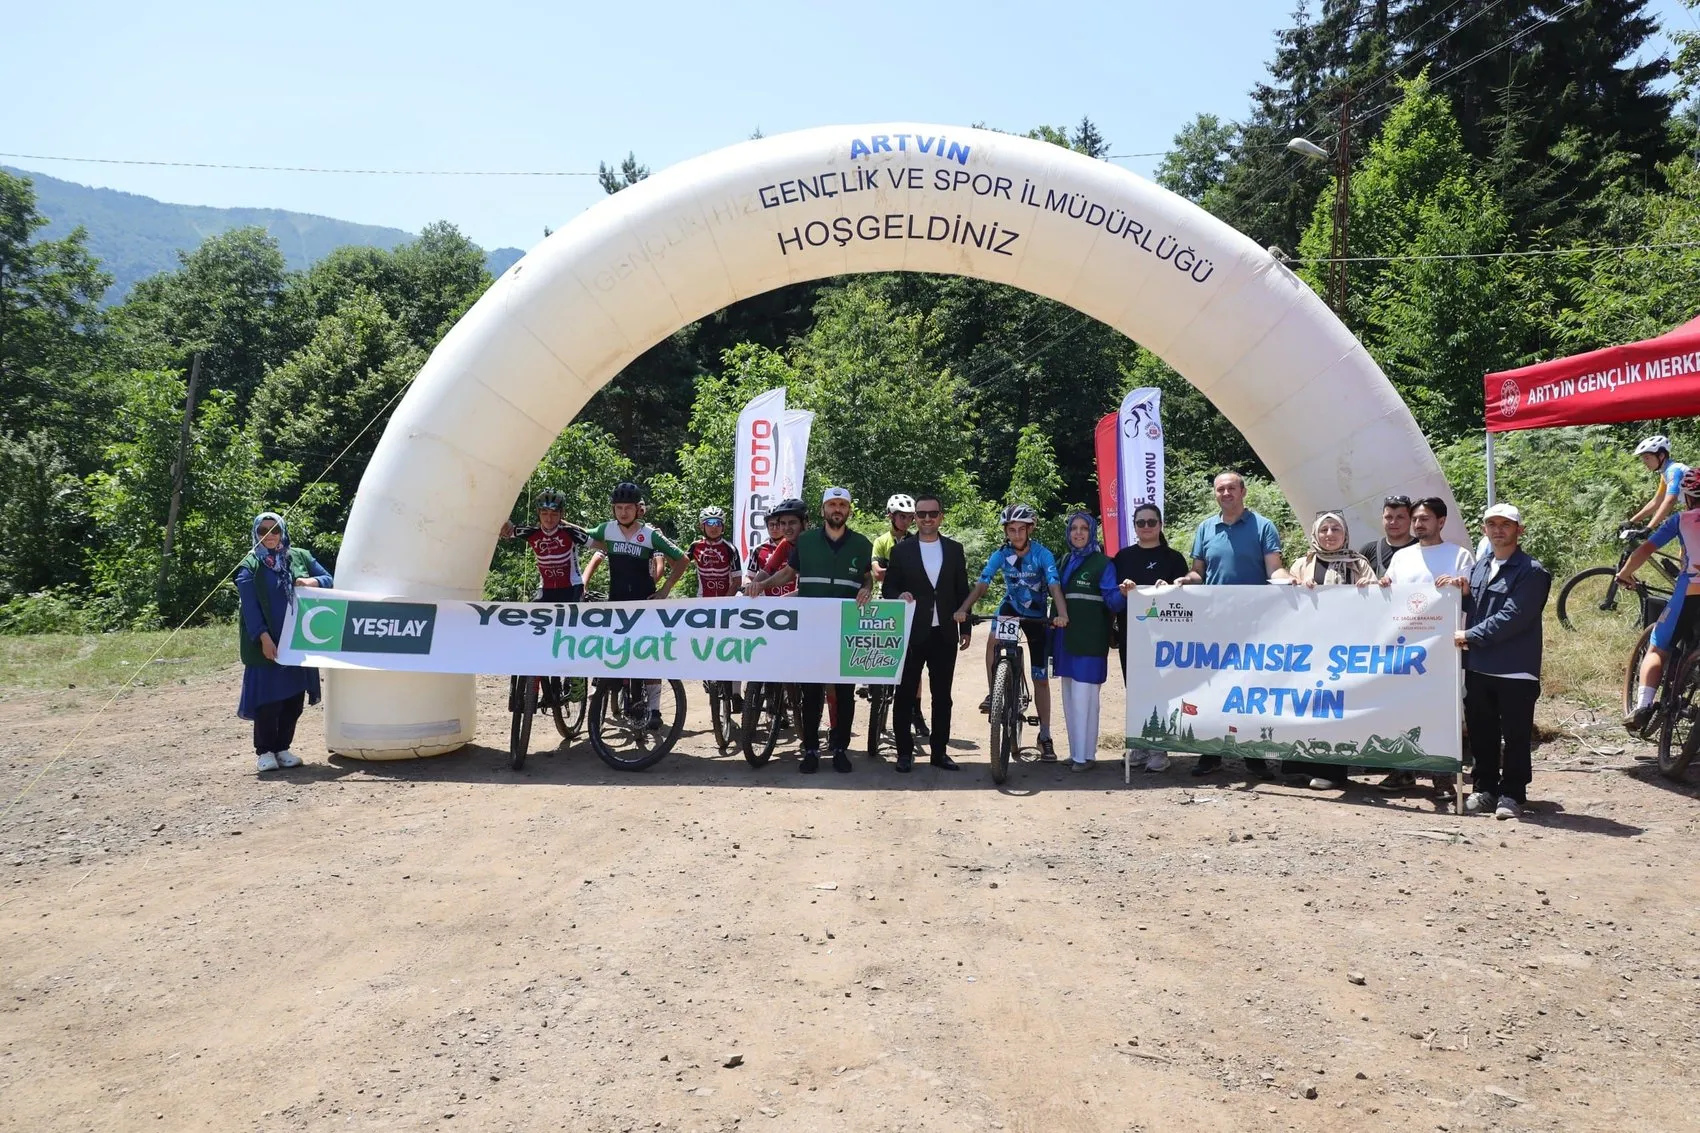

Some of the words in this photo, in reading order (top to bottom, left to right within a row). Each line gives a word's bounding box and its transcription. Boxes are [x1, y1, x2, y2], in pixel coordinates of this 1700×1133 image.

[851, 133, 971, 166] ARTVİN
[758, 165, 880, 209] GENÇLİK
[887, 168, 924, 189] VE
[934, 168, 1013, 200] SPOR
[776, 213, 1020, 257] HOŞGELDİNİZ
[1577, 361, 1642, 393] GENÇLİK
[751, 419, 772, 492] TOTO
[1144, 452, 1157, 505] ASYONU
[749, 493, 770, 557] POR
[467, 603, 645, 635] Yeşilay
[654, 607, 798, 631] varsa
[859, 617, 896, 630] mart
[1169, 602, 1184, 610] T.C.
[844, 633, 902, 651] YEŞİLAY
[998, 622, 1016, 635] 18
[552, 628, 678, 670] hayat
[690, 635, 767, 664] var
[849, 648, 898, 671] haftası
[1154, 640, 1312, 673] DUMANSIZ
[1328, 635, 1428, 681] ŞEHİR
[1221, 680, 1345, 720] ARTVİN
